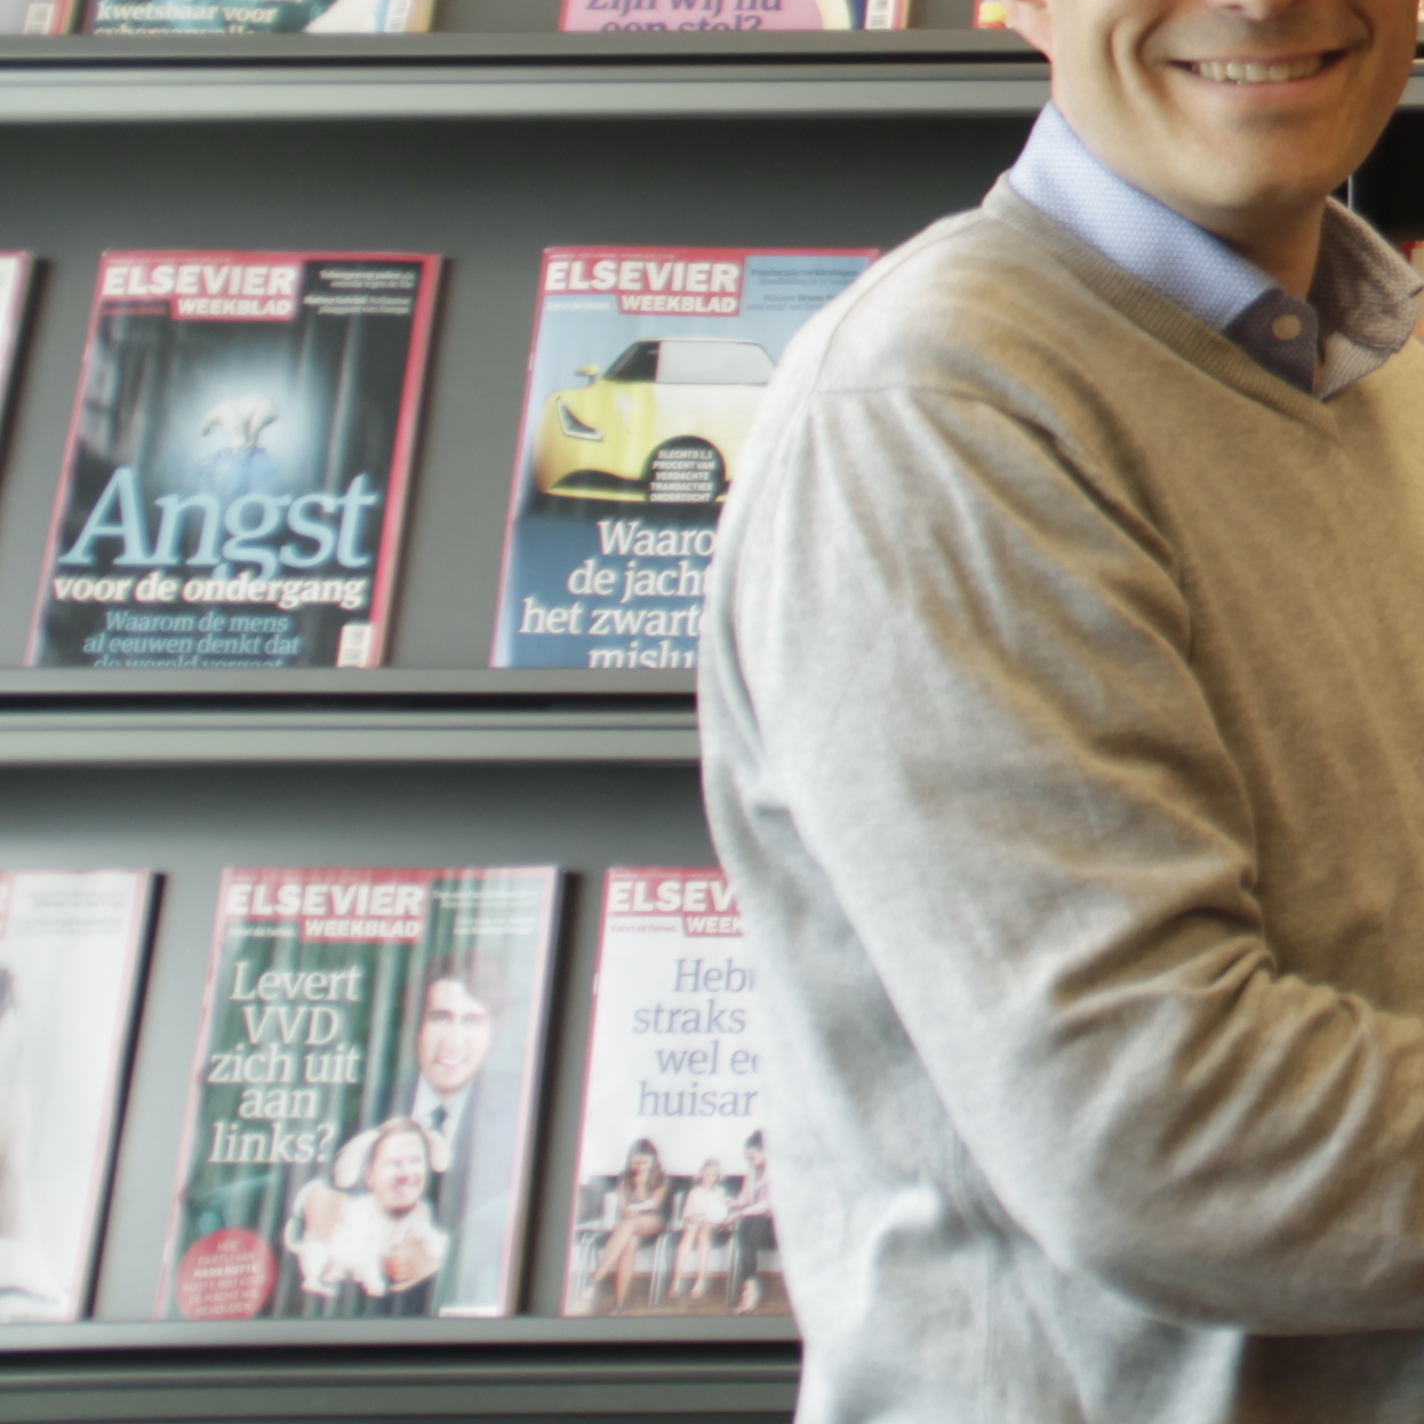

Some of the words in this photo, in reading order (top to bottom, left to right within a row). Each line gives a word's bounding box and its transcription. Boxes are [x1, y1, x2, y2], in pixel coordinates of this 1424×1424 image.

[103, 265, 295, 296] ELSEVIER
[545, 260, 740, 292] ELSEVIER
[177, 297, 292, 315] WEEKBLAD
[622, 296, 737, 313] WEEKBLAD
[57, 467, 376, 580] Angst
[598, 521, 717, 556] Waaro
[53, 575, 128, 601] voor
[135, 572, 176, 601] de
[183, 573, 364, 610] ondergang
[107, 611, 193, 632] Waarom
[201, 611, 226, 632] de
[231, 614, 288, 633] mens
[226, 885, 424, 916] ELSEVIER
[306, 920, 421, 938] WEEKBLAD
[231, 962, 359, 1001] Levert
[243, 1006, 338, 1045] VVD
[632, 999, 745, 1034] straks
[209, 1043, 292, 1083] zich
[304, 1045, 359, 1083] uit
[656, 1040, 718, 1075] wel
[239, 1087, 317, 1118] aan
[209, 1122, 334, 1163] links?
